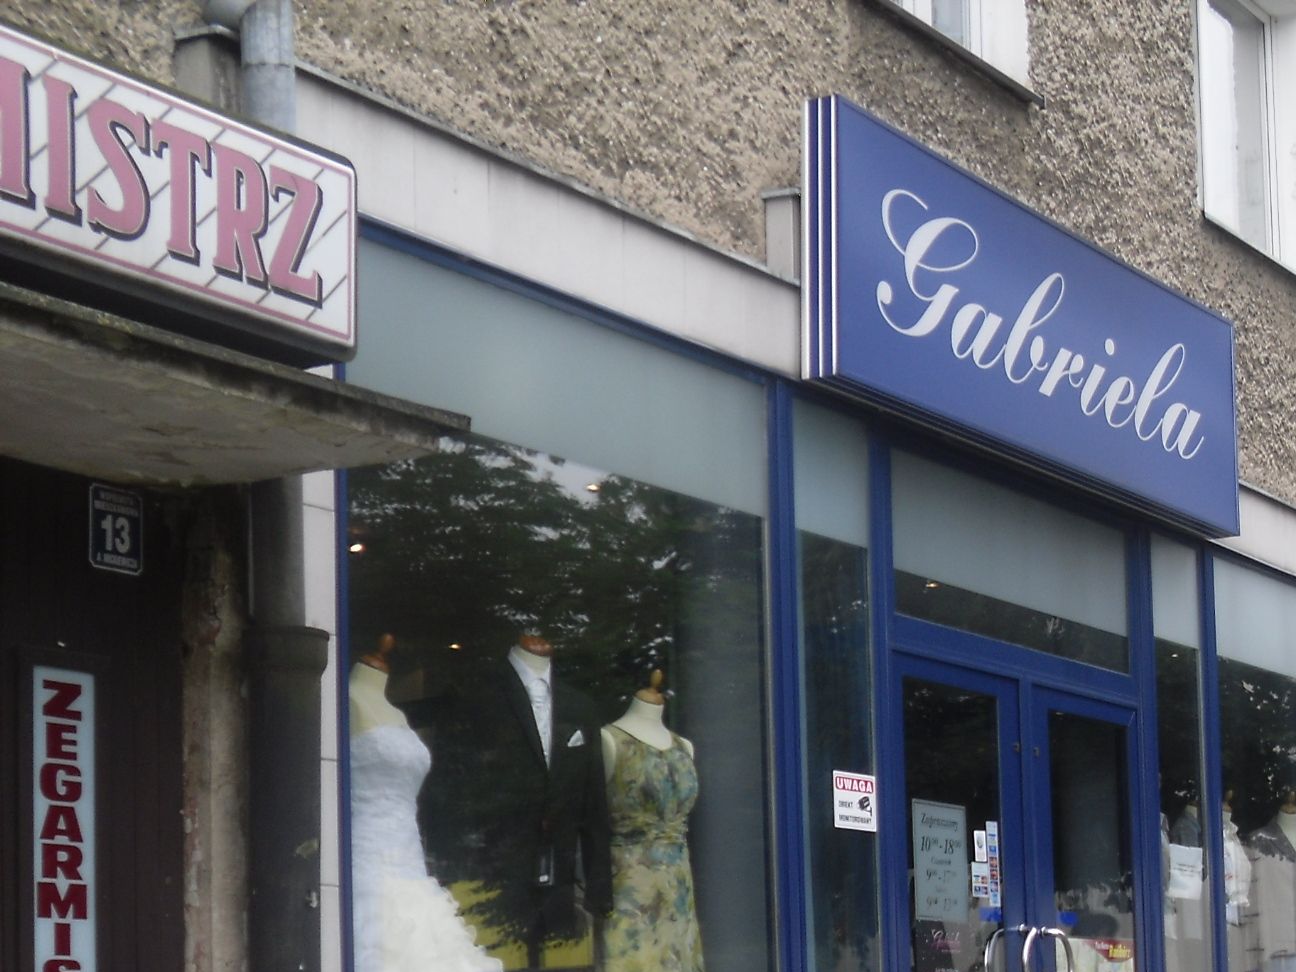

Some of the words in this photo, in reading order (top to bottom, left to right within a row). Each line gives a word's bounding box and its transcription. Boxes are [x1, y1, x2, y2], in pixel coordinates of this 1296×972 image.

[876, 188, 1205, 460] Gabriela
[101, 514, 130, 554] 13
[836, 777, 873, 793] UWAGA
